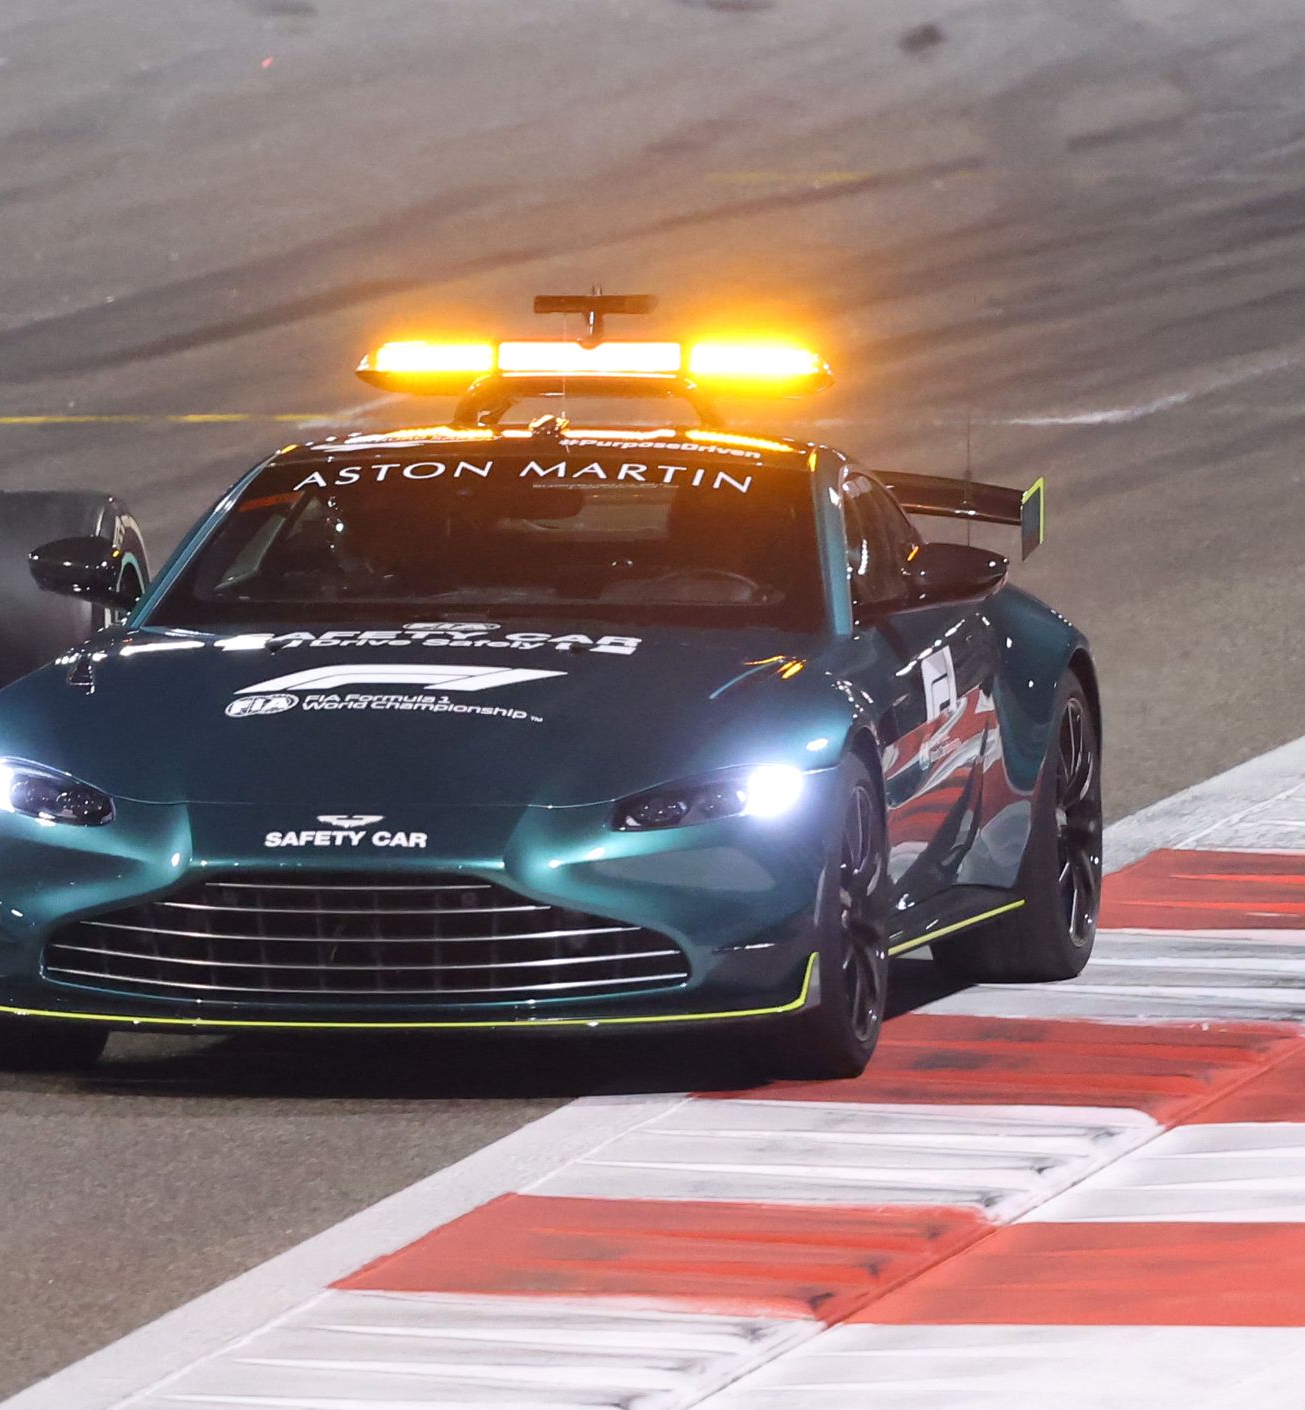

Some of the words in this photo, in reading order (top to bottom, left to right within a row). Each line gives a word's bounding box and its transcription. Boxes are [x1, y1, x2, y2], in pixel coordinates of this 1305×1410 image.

[558, 438, 762, 459] #PurposeDriven
[292, 460, 494, 491] ASTON
[518, 460, 753, 494] MARTIN
[309, 639, 412, 648] Drive
[422, 639, 545, 650] Safely
[504, 632, 643, 647] CAR
[305, 694, 341, 702] FIA
[344, 694, 437, 704] Formula
[438, 695, 451, 704] 1
[302, 701, 366, 711] World
[370, 702, 528, 719] Championship
[264, 830, 367, 847] SAFETY
[371, 831, 428, 848] CAR
